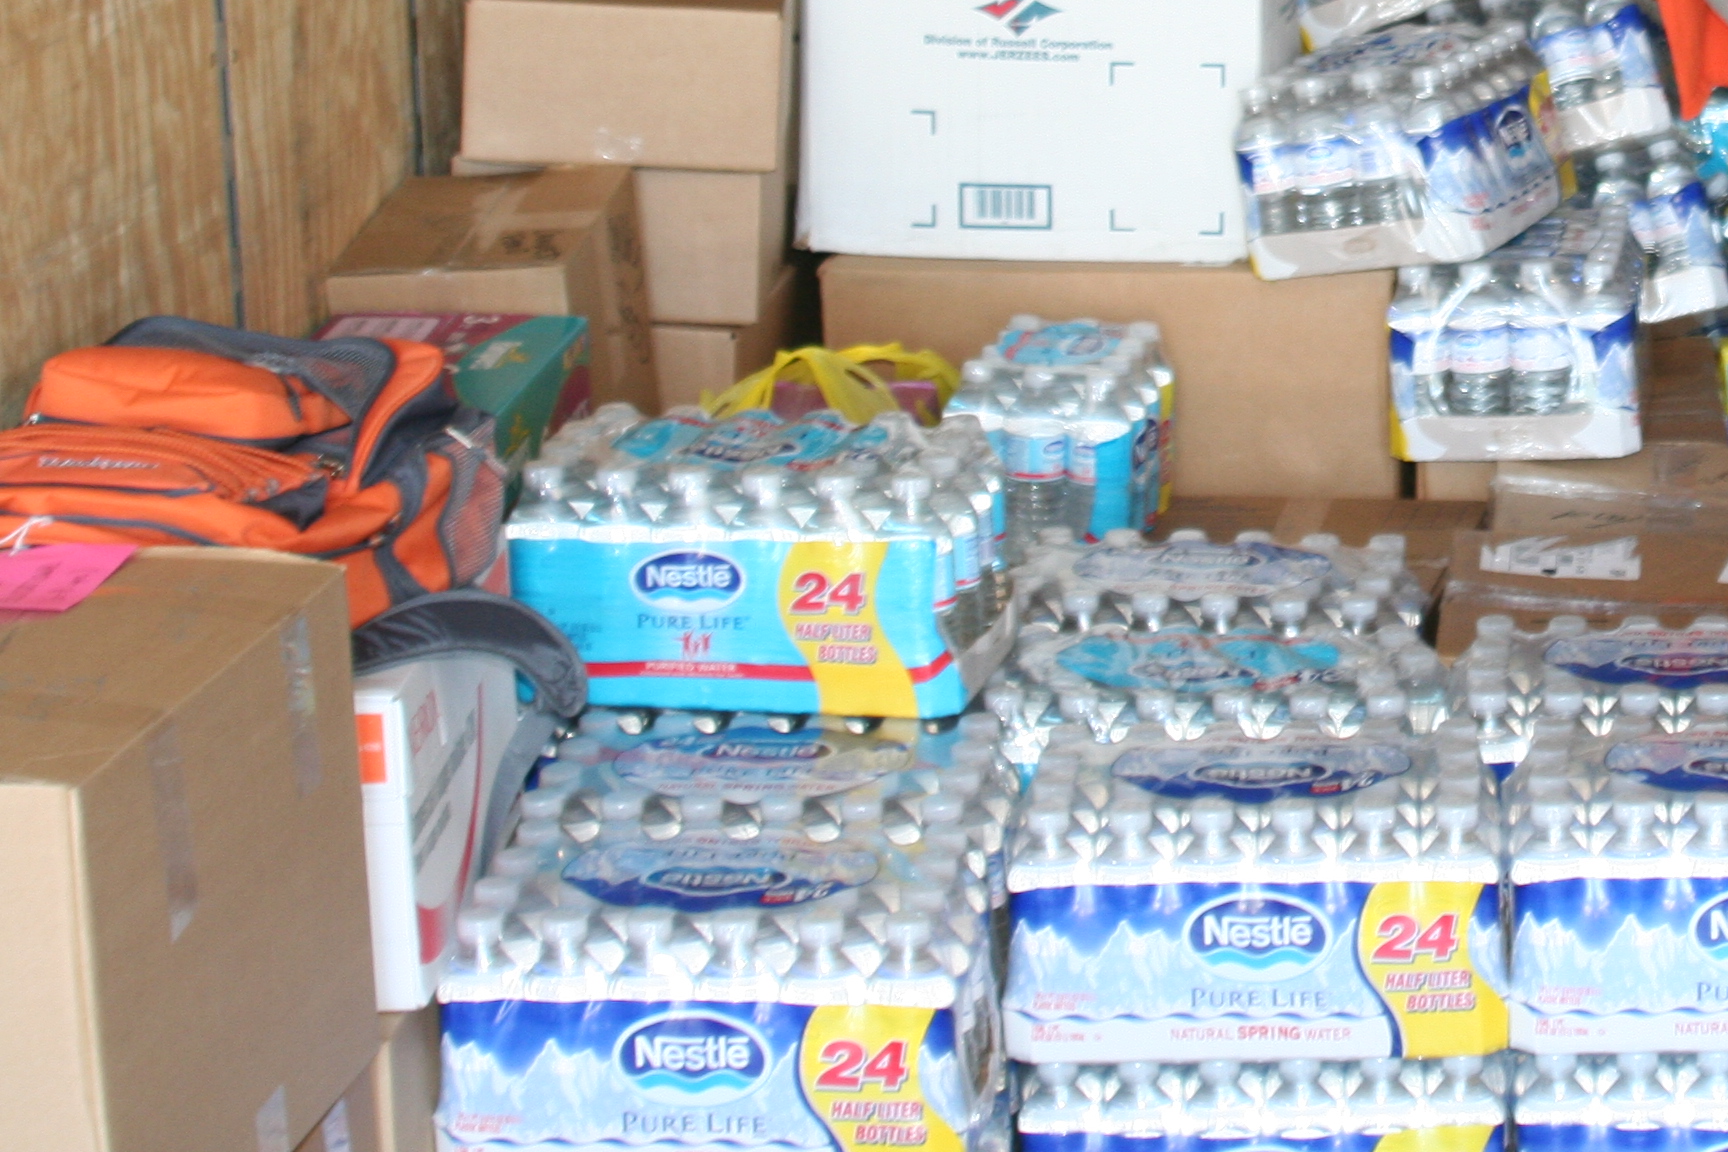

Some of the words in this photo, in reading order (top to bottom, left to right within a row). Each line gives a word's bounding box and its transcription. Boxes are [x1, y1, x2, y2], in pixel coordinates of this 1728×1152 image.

[975, 35, 988, 46] of
[1040, 38, 1114, 51] Corporation
[789, 569, 866, 616] 24
[637, 614, 692, 630] PURE
[700, 615, 743, 630] LIFE
[795, 623, 829, 641] HALF
[829, 624, 872, 642] LITER
[817, 645, 878, 665] BOTTLES
[1371, 912, 1460, 964] 24
[1384, 972, 1424, 993] HALF
[1425, 970, 1472, 991] LITER
[1190, 987, 1267, 1008] PURE
[1272, 988, 1328, 1008] LIFE
[1405, 991, 1477, 1014] BOTTLES
[1170, 1028, 1234, 1041] NATURAL
[1236, 1024, 1301, 1041] SPRING
[1304, 1027, 1353, 1041] WATER
[814, 1038, 911, 1093] 24
[831, 1100, 875, 1122] HALF
[876, 1101, 923, 1122] LITER
[622, 1111, 697, 1135] PURE
[707, 1112, 768, 1135] LIFE
[854, 1124, 928, 1146] BOTTLES
